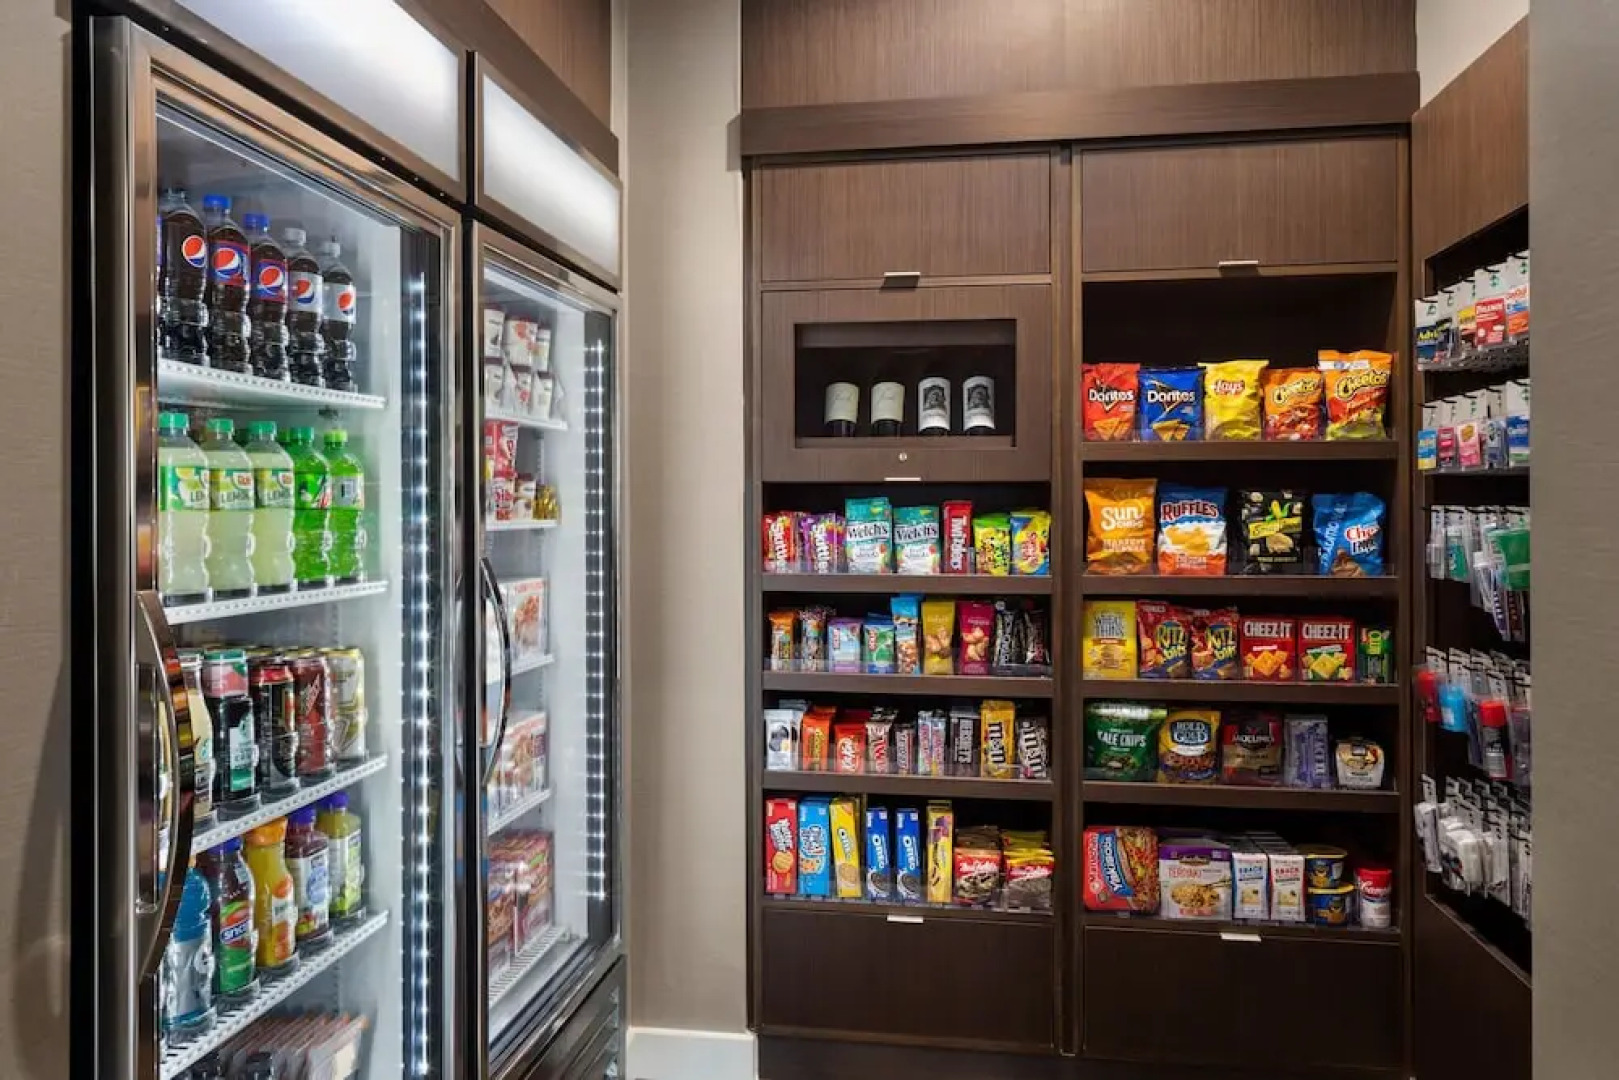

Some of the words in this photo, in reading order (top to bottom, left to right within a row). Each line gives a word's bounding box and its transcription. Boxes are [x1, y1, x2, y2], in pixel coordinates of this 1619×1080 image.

[1088, 388, 1135, 401] Doritos
[1147, 388, 1196, 403] Doritos
[1161, 500, 1219, 523] RUFFLES
[848, 523, 888, 539] Welch's
[1244, 621, 1292, 639] CHEEZ-IT
[1302, 622, 1351, 640] CHEEZ-IT
[872, 834, 886, 869] OREO
[903, 835, 917, 871] OREO
